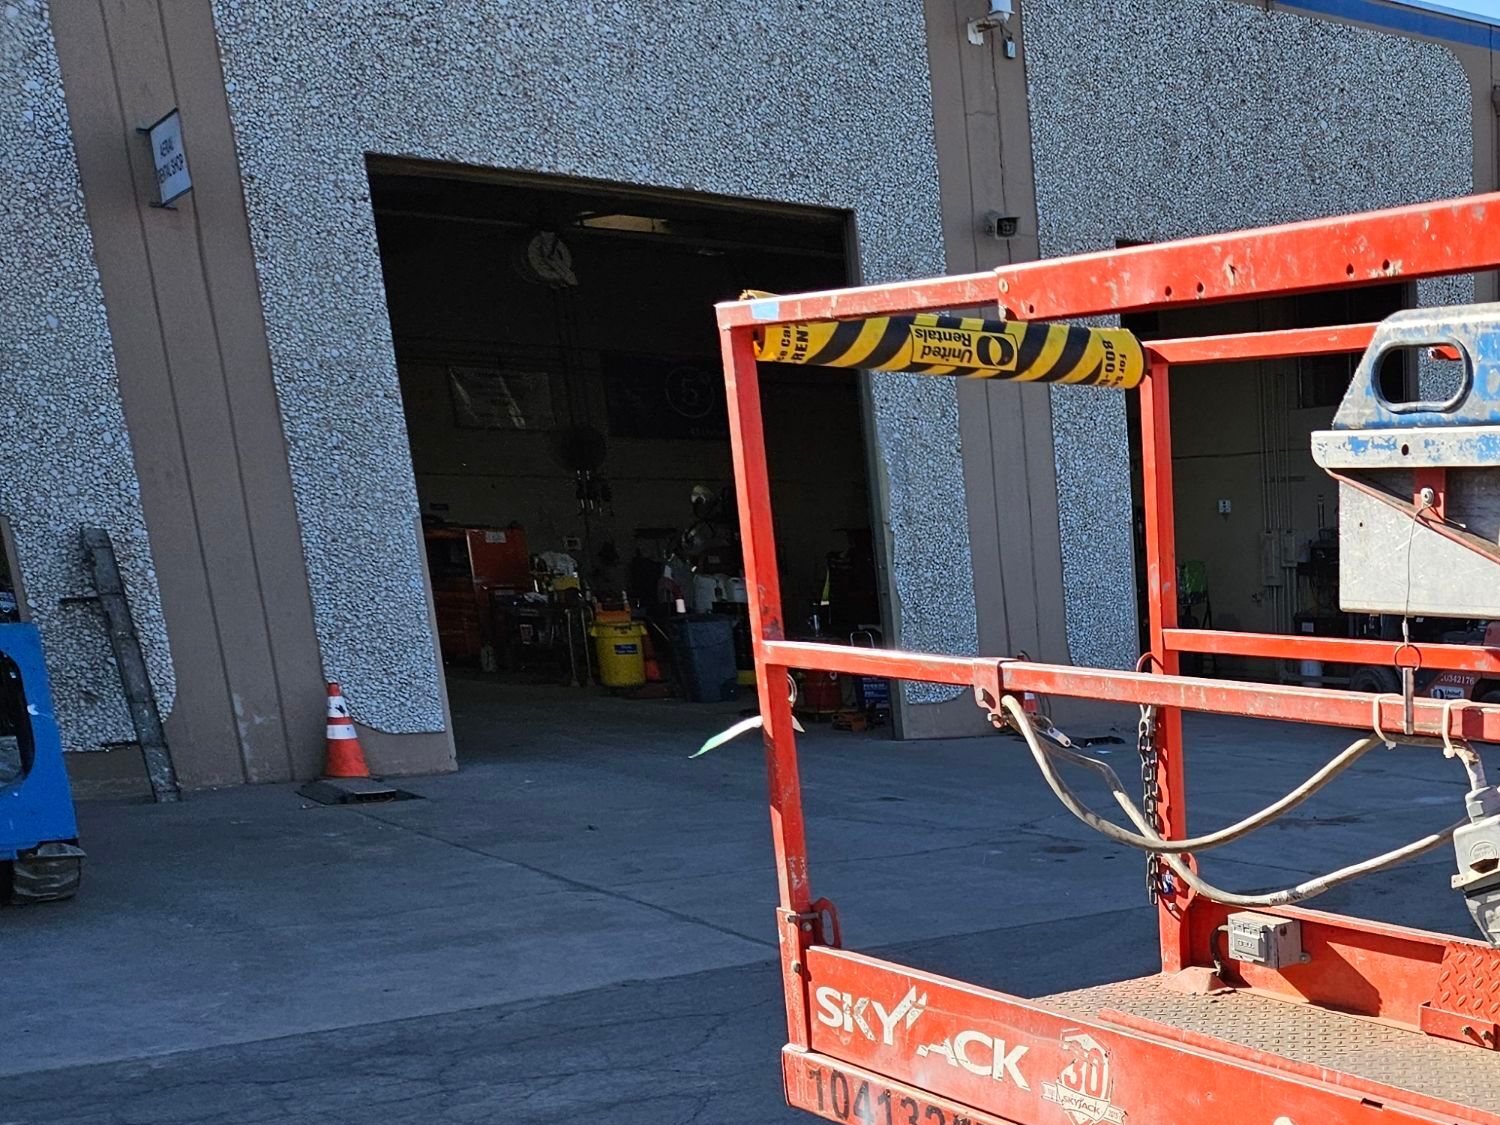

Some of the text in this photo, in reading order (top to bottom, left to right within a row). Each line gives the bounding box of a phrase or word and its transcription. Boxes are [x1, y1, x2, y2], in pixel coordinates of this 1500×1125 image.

[915, 328, 972, 343] Rentals
[921, 344, 973, 364] United
[1063, 1095, 1101, 1115] SKYJACK
